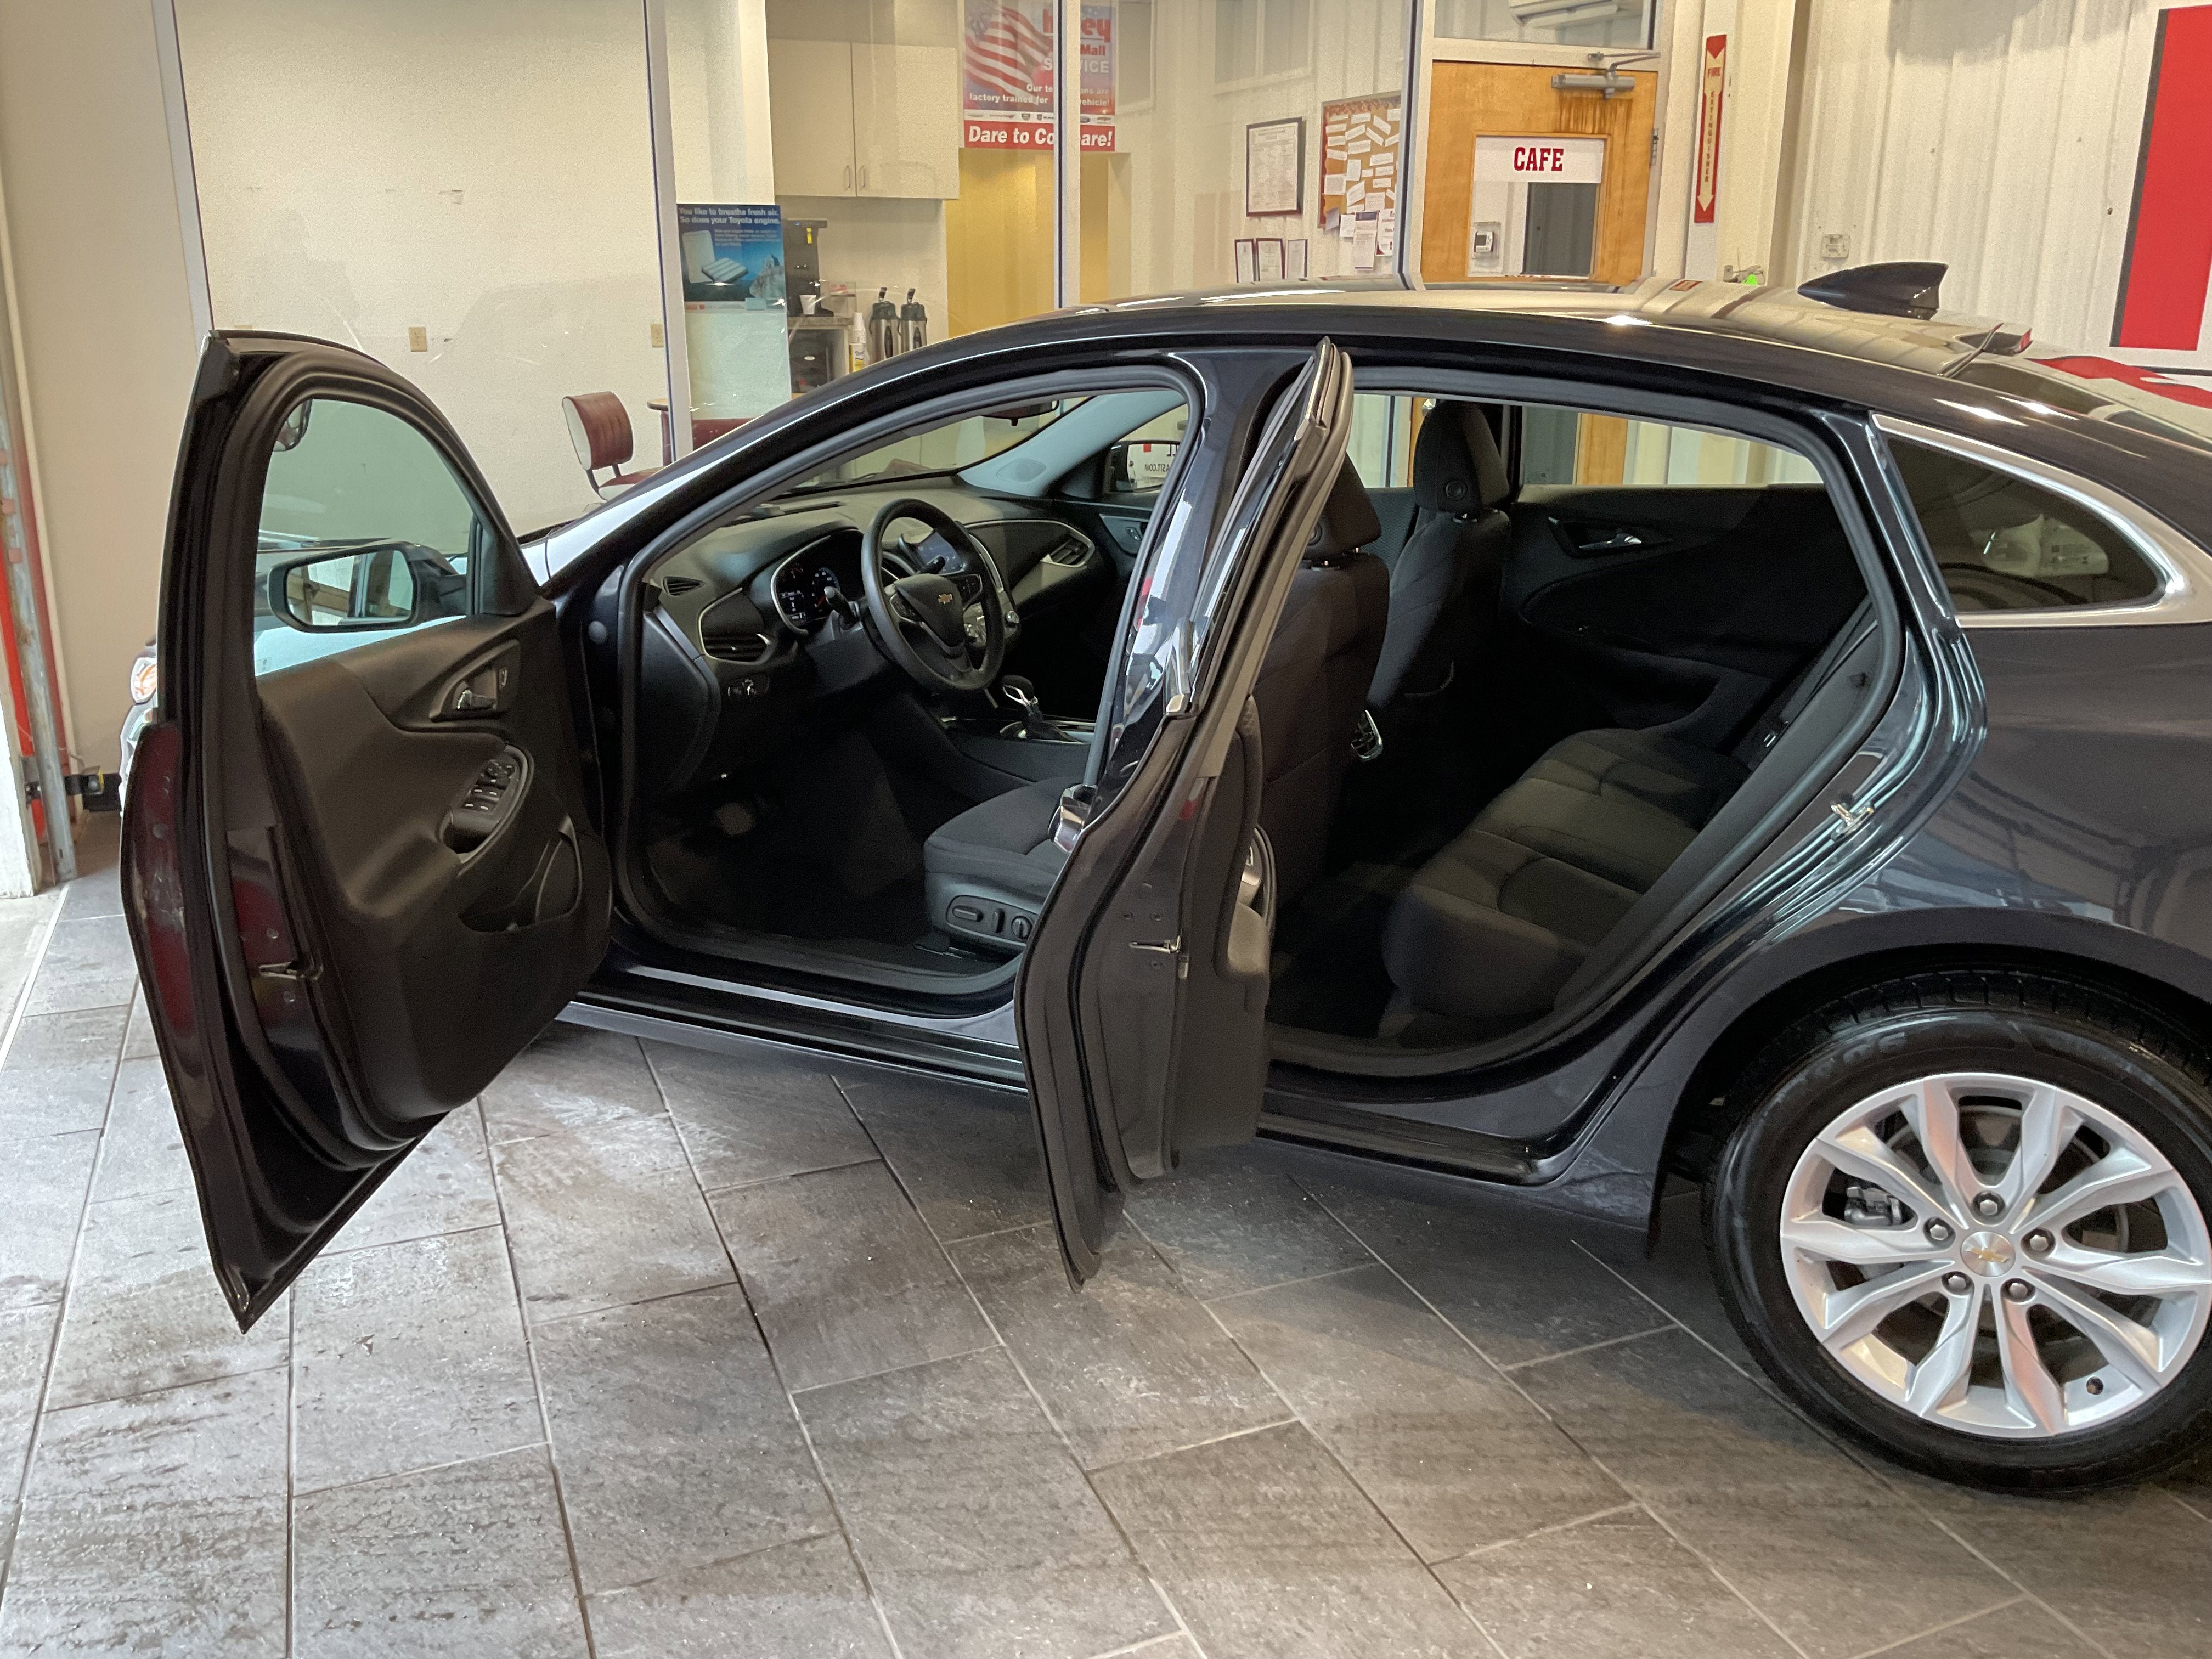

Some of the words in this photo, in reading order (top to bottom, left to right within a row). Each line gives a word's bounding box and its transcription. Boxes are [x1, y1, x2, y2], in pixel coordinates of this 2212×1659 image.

[1707, 67, 1721, 77] FIRE
[1026, 84, 1042, 92] Our
[969, 93, 1000, 103] factory
[1003, 94, 1032, 103] trained
[968, 126, 1008, 143] Dare
[1013, 128, 1030, 144] to
[1705, 91, 1715, 182] EXTINGUISHER
[1514, 146, 1564, 171] CAFE
[728, 217, 752, 225] Toyota
